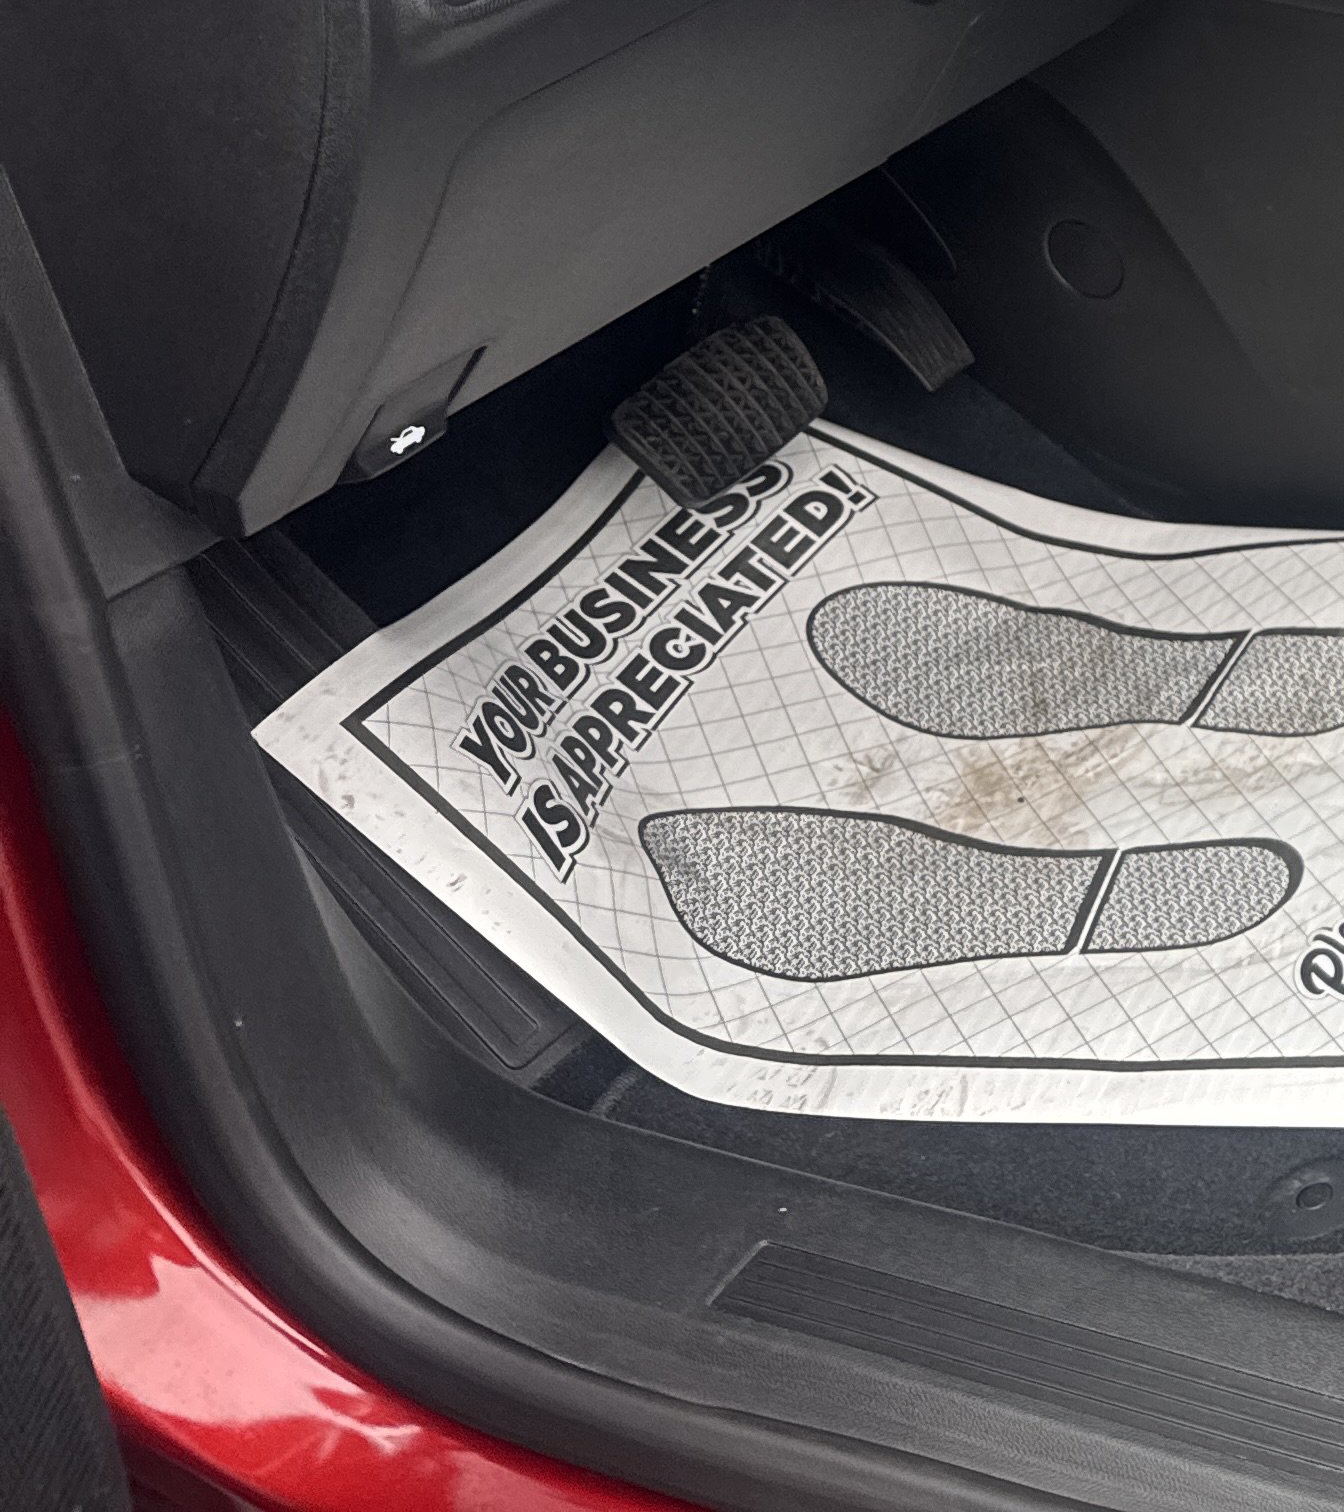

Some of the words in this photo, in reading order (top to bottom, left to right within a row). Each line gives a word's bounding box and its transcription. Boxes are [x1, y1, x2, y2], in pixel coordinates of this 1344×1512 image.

[550, 467, 872, 818] APPRECIATED!
[456, 662, 560, 789] YOUR
[520, 783, 588, 876] IS
